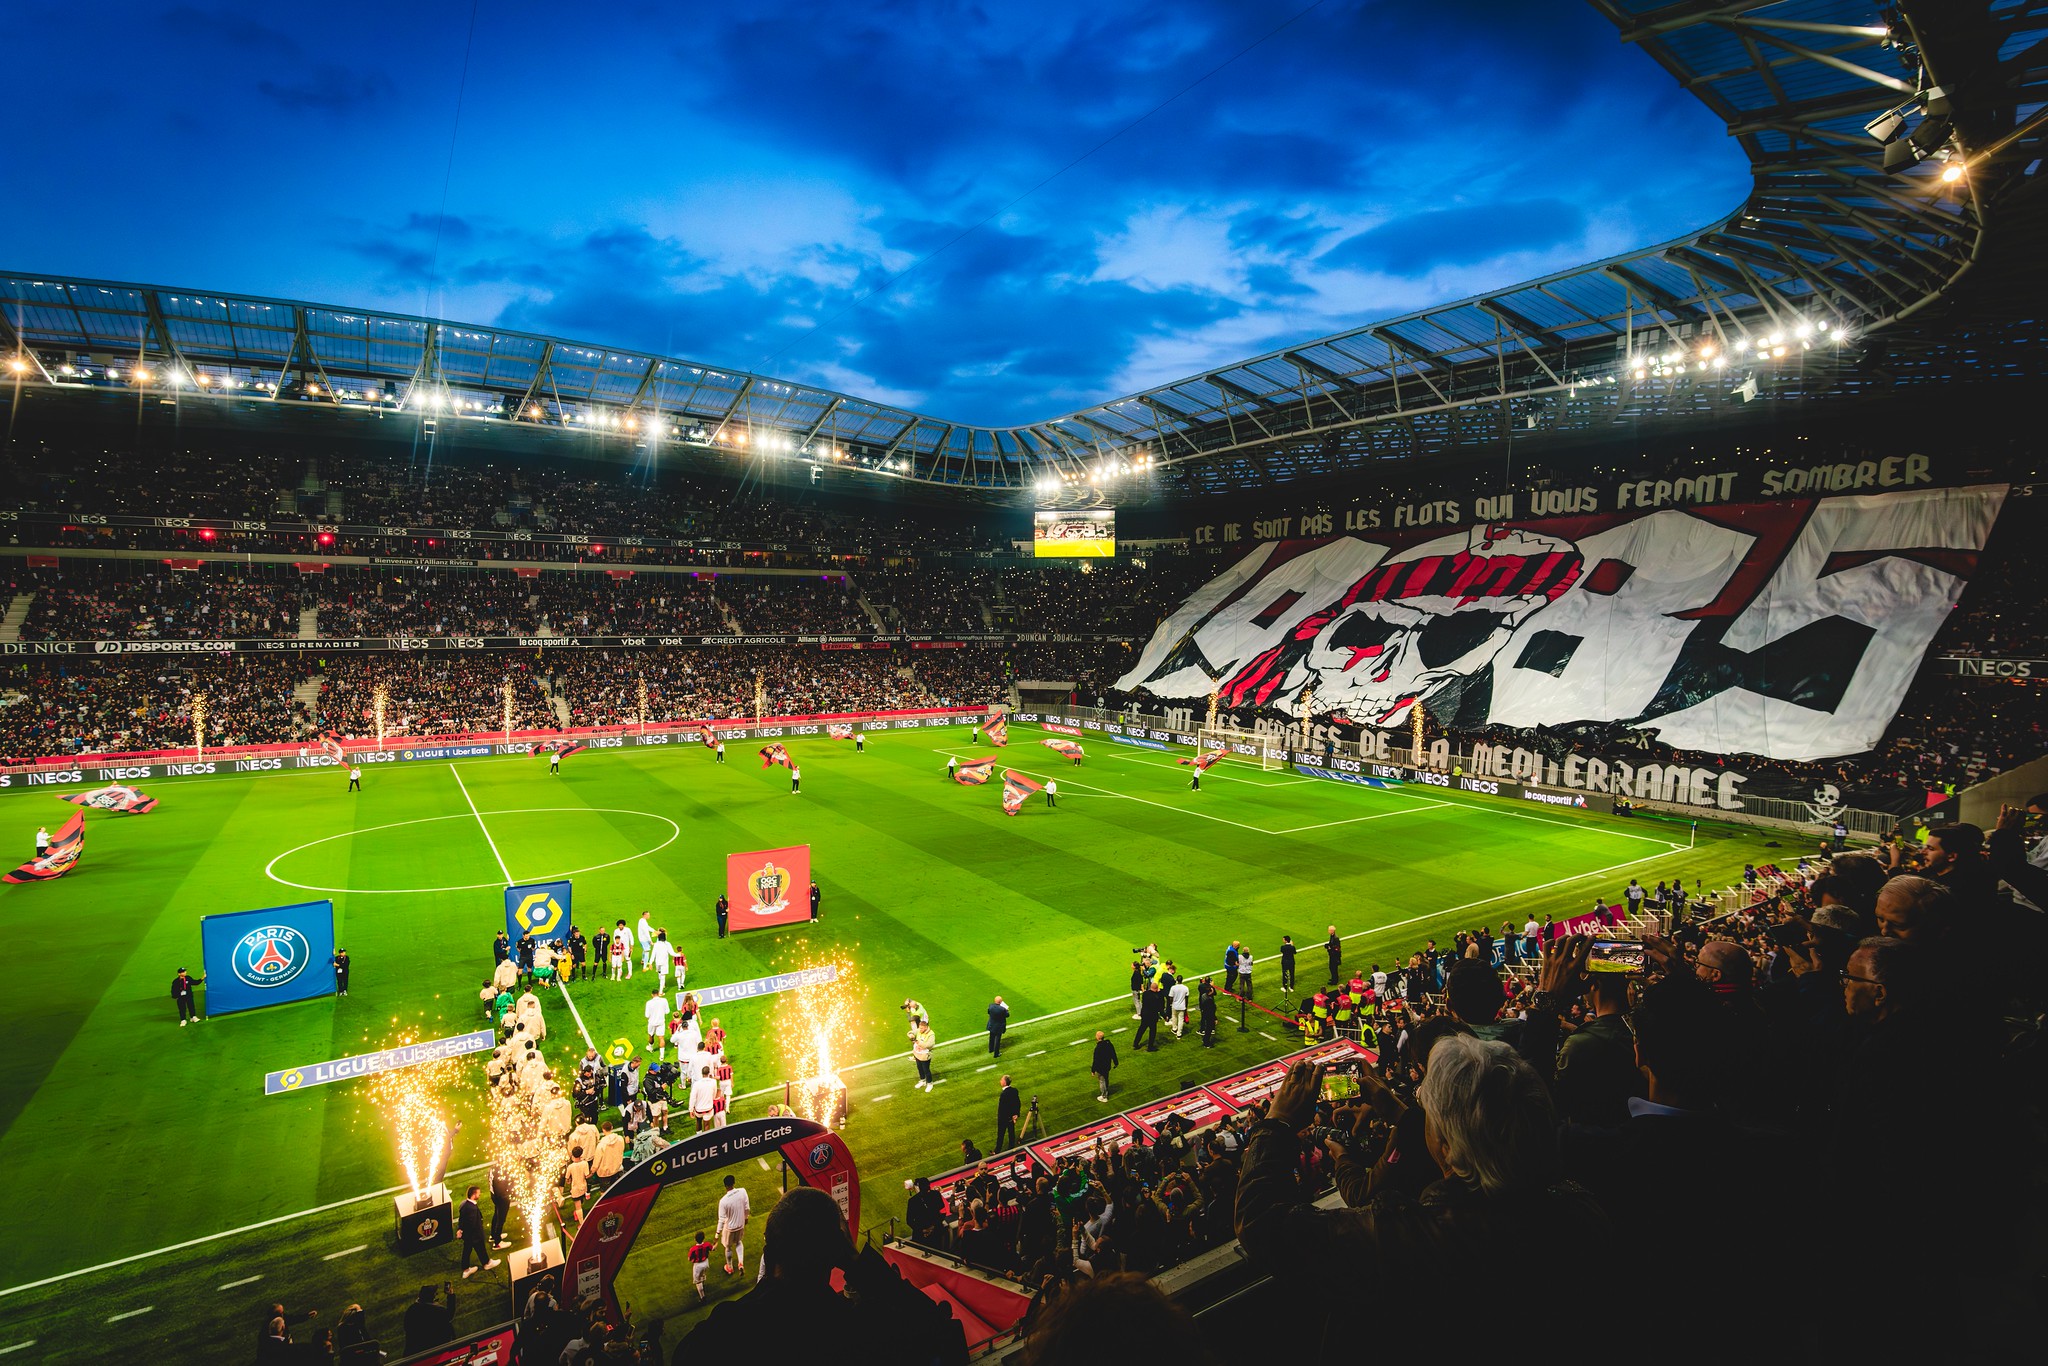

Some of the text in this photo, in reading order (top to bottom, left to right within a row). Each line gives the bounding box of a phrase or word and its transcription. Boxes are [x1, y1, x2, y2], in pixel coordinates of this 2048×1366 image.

[1195, 453, 1933, 545] CE NE SONT PAS LES FLOTS QUI VOUS FERONT SOMBRER
[69, 514, 107, 524] INEOS
[154, 518, 190, 527] INEOS
[233, 521, 267, 530] INEOS
[308, 524, 339, 533] INEOS
[378, 527, 407, 536] INEOS
[444, 530, 472, 538] INEOS
[505, 532, 532, 541] INEOS
[563, 535, 589, 543] INEOS
[618, 537, 642, 545] INEOS
[4, 642, 76, 654] DE NICE
[123, 642, 236, 652] JDSPORTS.COM
[388, 638, 484, 649] INEOS INEOS
[519, 637, 569, 647] le coq sportif
[621, 637, 683, 645] vbet vbet
[1958, 659, 2032, 677] INEOS
[589, 737, 623, 748] INEOS
[636, 734, 668, 745] INEOS
[677, 733, 701, 743] INEO
[717, 729, 747, 740] INEOS
[754, 727, 783, 738] INEOS
[791, 725, 819, 735] INEOS
[862, 721, 888, 731] INEOS
[895, 719, 919, 728] INEOS
[926, 717, 950, 726] INEOS
[955, 715, 978, 724] INEOS
[1054, 726, 1079, 735] vbet
[496, 742, 532, 755] INEOS
[1359, 729, 1395, 760] DE
[416, 750, 444, 758] LIGUE
[1013, 714, 1499, 795] INEOS INEOS INEOS INEOS INEOS INEOS INEOS INEOS INEOS INEOS INEOS INEOS INEOS INEO INEOS INEOS
[27, 770, 82, 785] INEOS
[99, 766, 151, 781] INEOS
[167, 762, 216, 776] INEOS
[235, 758, 282, 771] INEOS
[353, 751, 395, 764] INEOS
[1309, 767, 1370, 785] INEOS
[1524, 789, 1572, 806] le coq sportif
[760, 876, 778, 884] OGC
[760, 881, 778, 890] NICE
[1573, 917, 1604, 936] vbet
[244, 928, 295, 947] PARIS
[246, 965, 297, 982] SAINT GERMAIN
[711, 970, 830, 1001] LIGUE 1 Uber Eats
[315, 1057, 381, 1082] LIGUE
[402, 1043, 442, 1063] Uber
[444, 1036, 484, 1054] Eats
[672, 1125, 793, 1169] LIGUE 1 Uber Eats
[579, 1272, 599, 1283] INEOS
